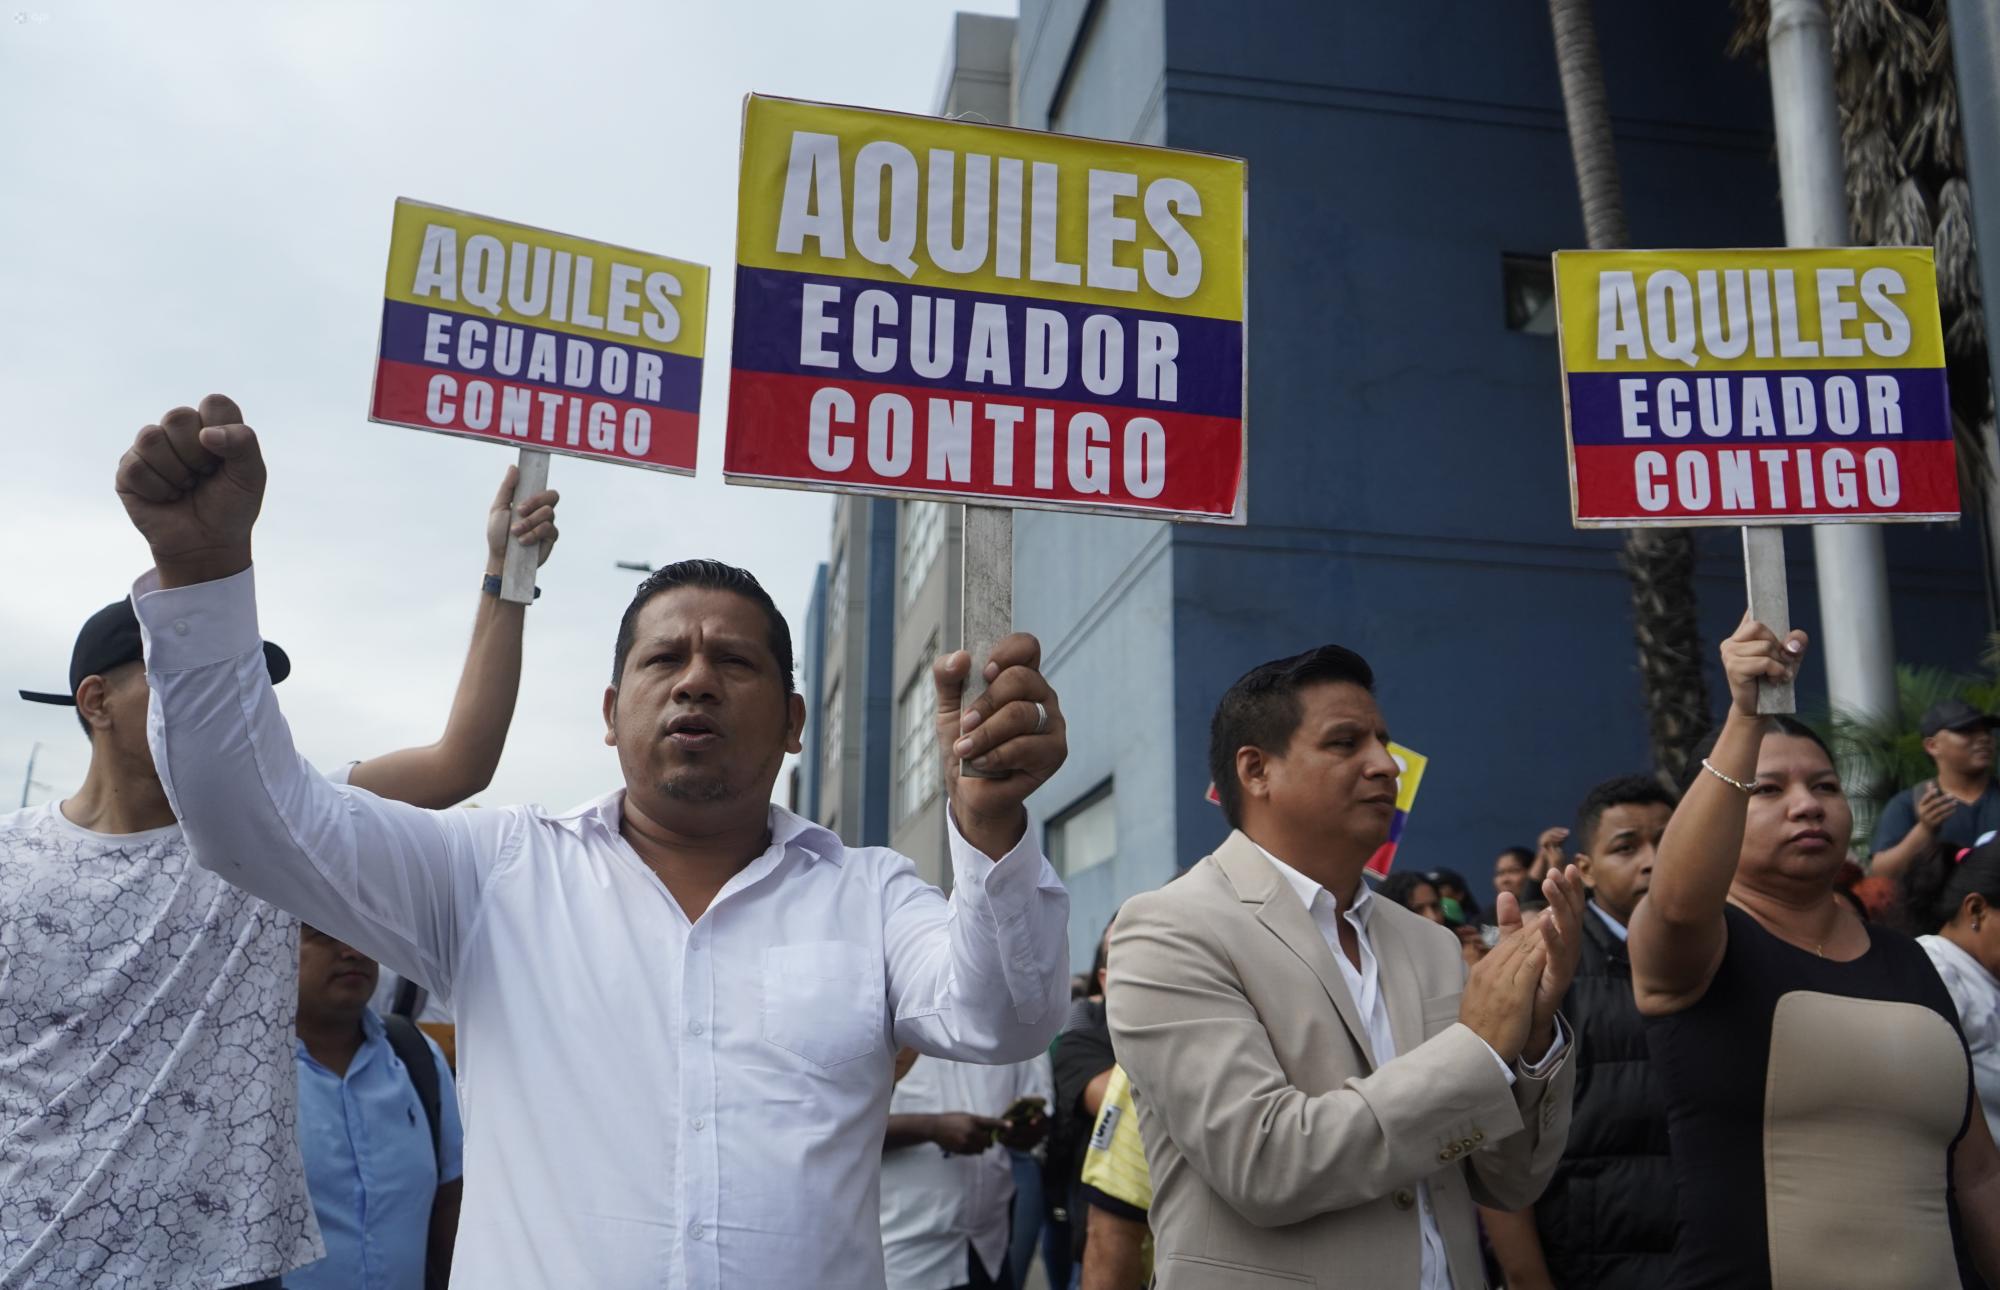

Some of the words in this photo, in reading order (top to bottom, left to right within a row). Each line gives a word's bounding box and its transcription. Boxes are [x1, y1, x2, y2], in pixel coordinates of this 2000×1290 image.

[776, 131, 1202, 298] AQUILES
[412, 224, 682, 343] AQUILES
[1597, 267, 1911, 367] AQUILES
[424, 313, 663, 402] ECUADOR
[800, 283, 1179, 402] ECUADOR
[426, 374, 652, 456] CONTIGO
[808, 387, 1166, 499] CONTIGO
[1619, 375, 1903, 438] ECUADOR
[1634, 447, 1900, 512] CONTIGO
